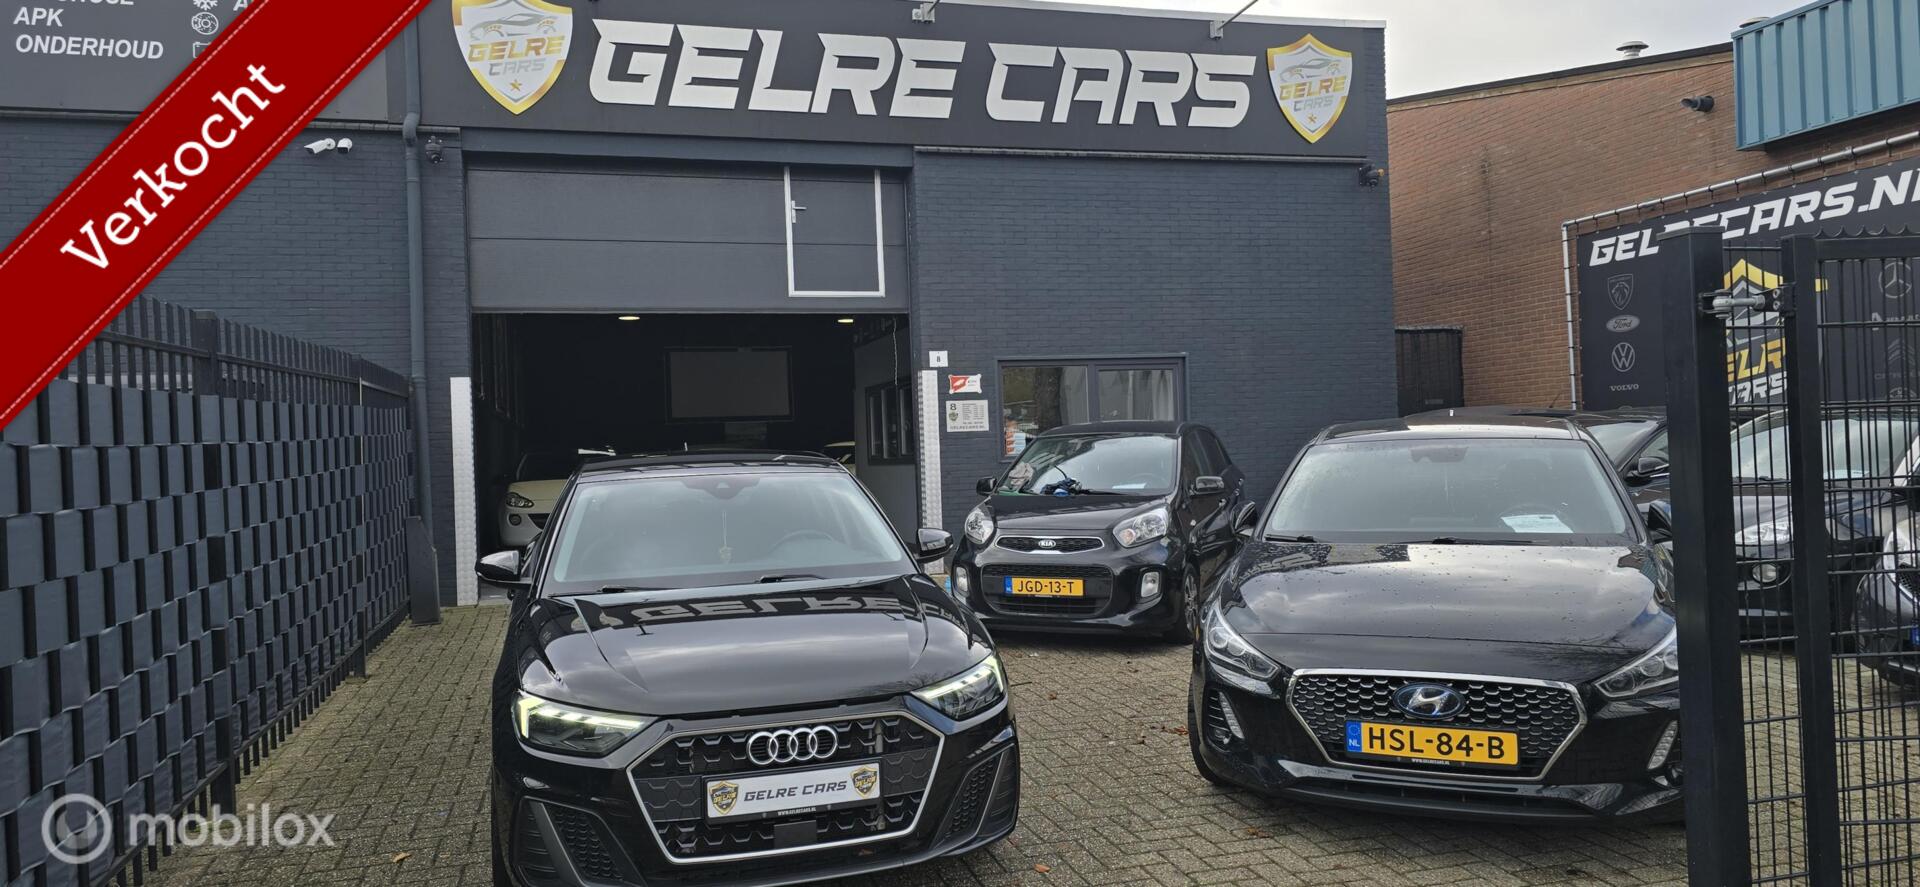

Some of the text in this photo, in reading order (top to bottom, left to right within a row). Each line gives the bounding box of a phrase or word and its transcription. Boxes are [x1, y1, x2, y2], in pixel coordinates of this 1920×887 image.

[13, 7, 64, 27] APK
[15, 34, 164, 60] ONDERHOUD
[468, 35, 566, 62] GELRE
[488, 58, 547, 76] CARS
[590, 19, 1256, 128] GELRE CARS
[1279, 75, 1347, 101] GELRE
[1293, 95, 1334, 112] CARS
[1610, 383, 1639, 392] VOLVO
[1018, 580, 1074, 593] JGD-13-T
[1348, 727, 1504, 759] NL HSL-84-B
[744, 787, 798, 802] GELRE
[802, 781, 847, 795] CARS
